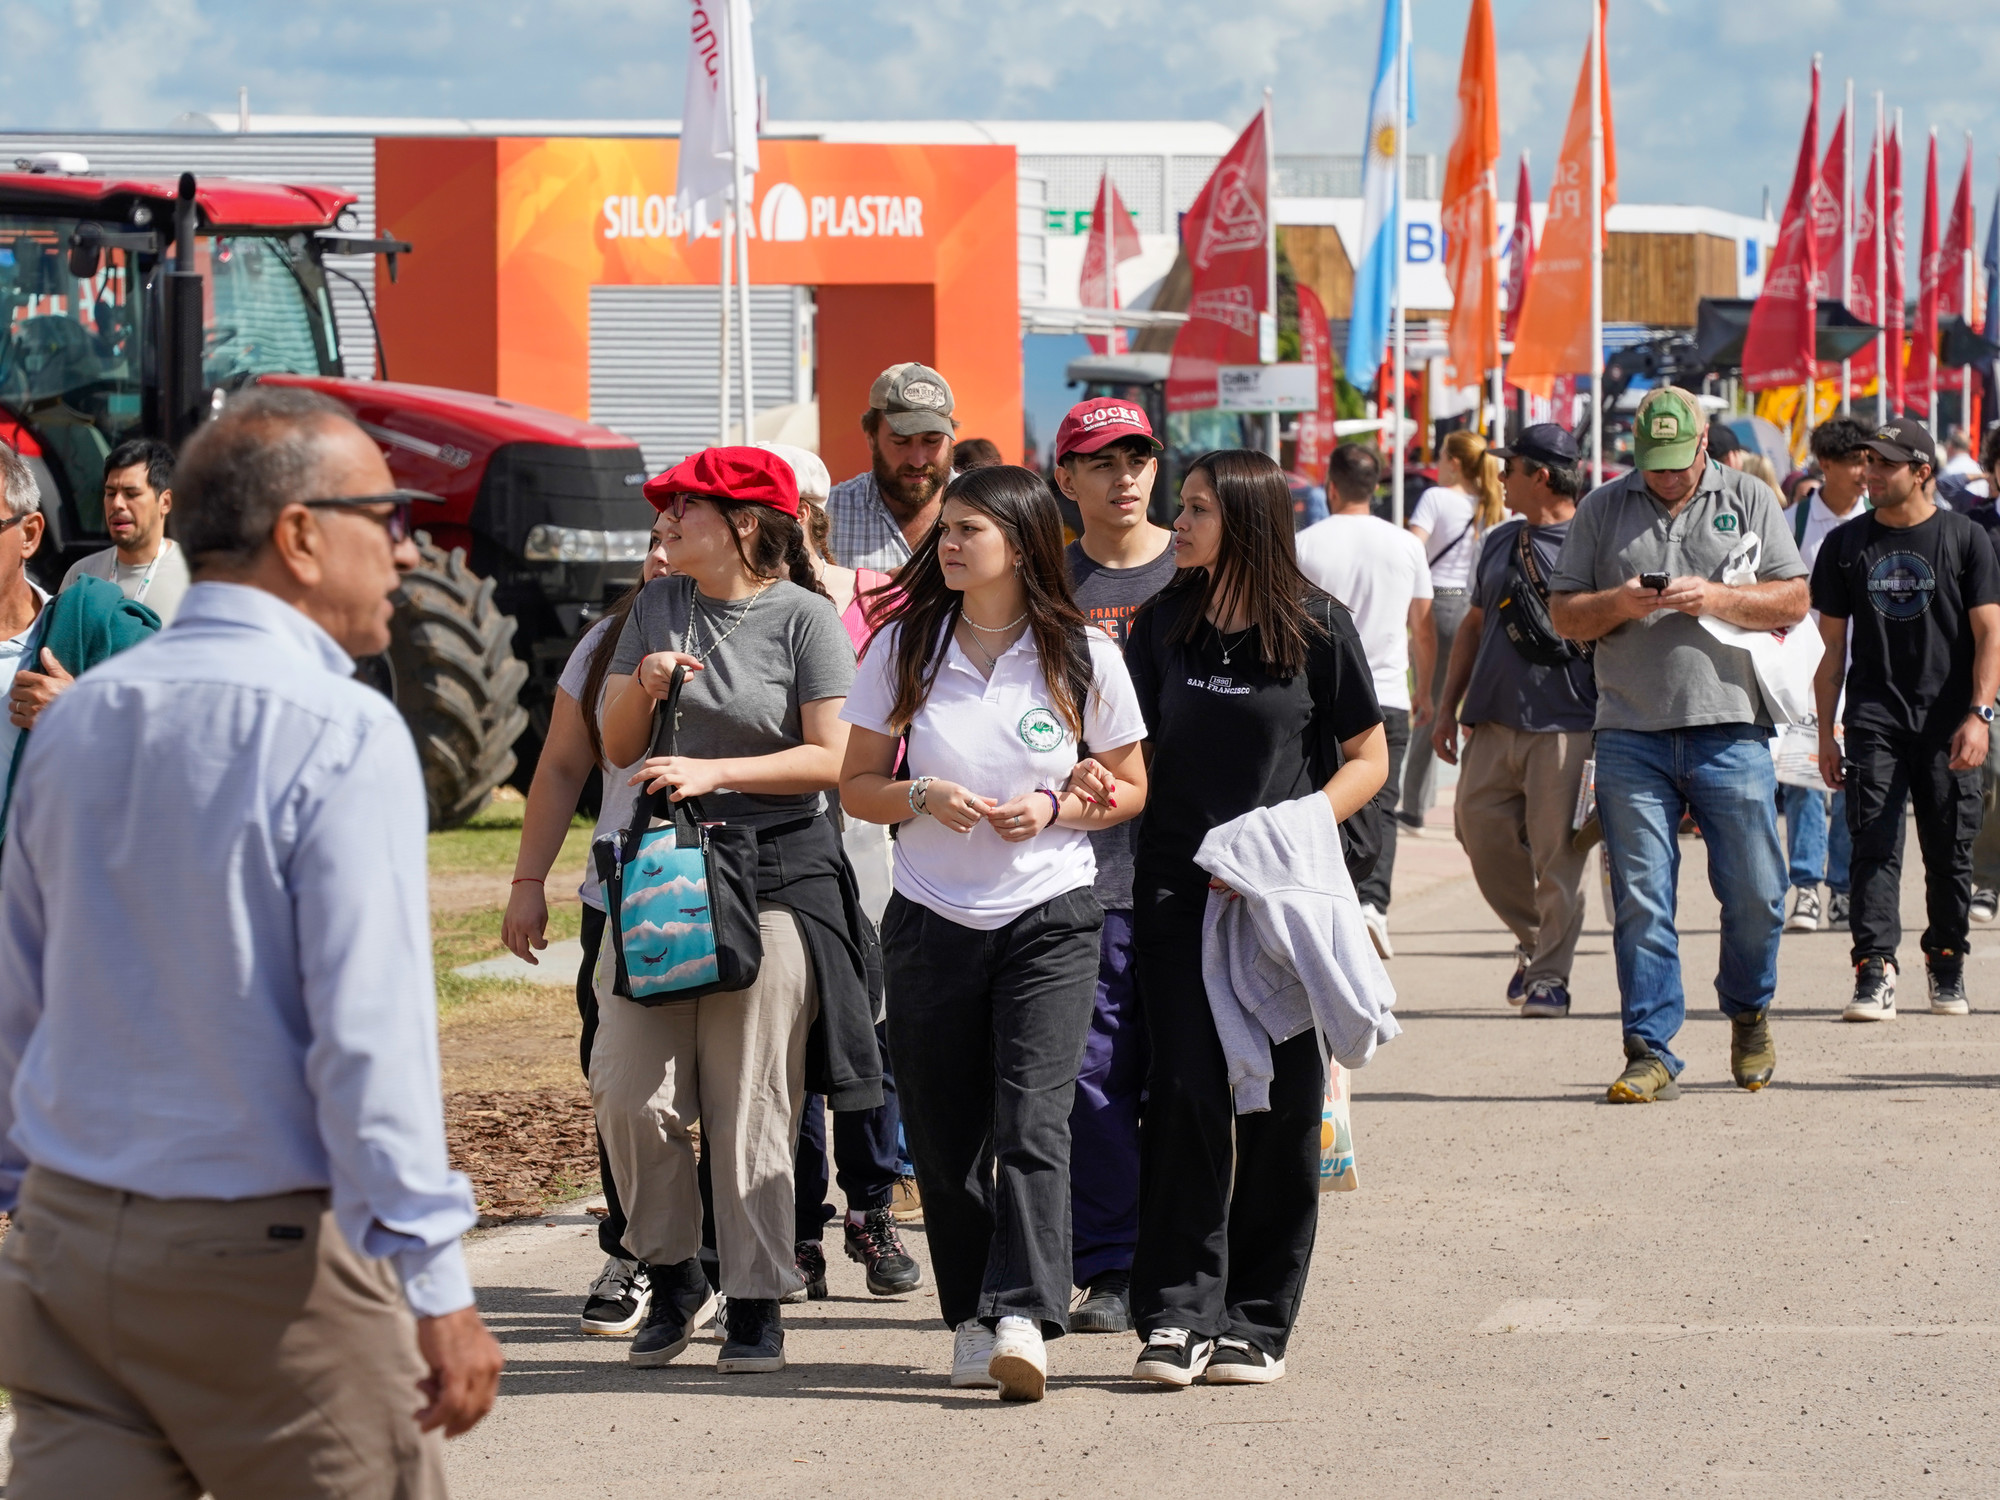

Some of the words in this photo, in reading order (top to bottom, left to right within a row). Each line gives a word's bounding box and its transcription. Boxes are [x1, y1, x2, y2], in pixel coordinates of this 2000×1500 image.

[811, 195, 923, 237] PLASTAR
[1083, 407, 1141, 425] COCKS
[1187, 678, 1205, 688] SAN
[1207, 683, 1251, 694] FRANCISCO
